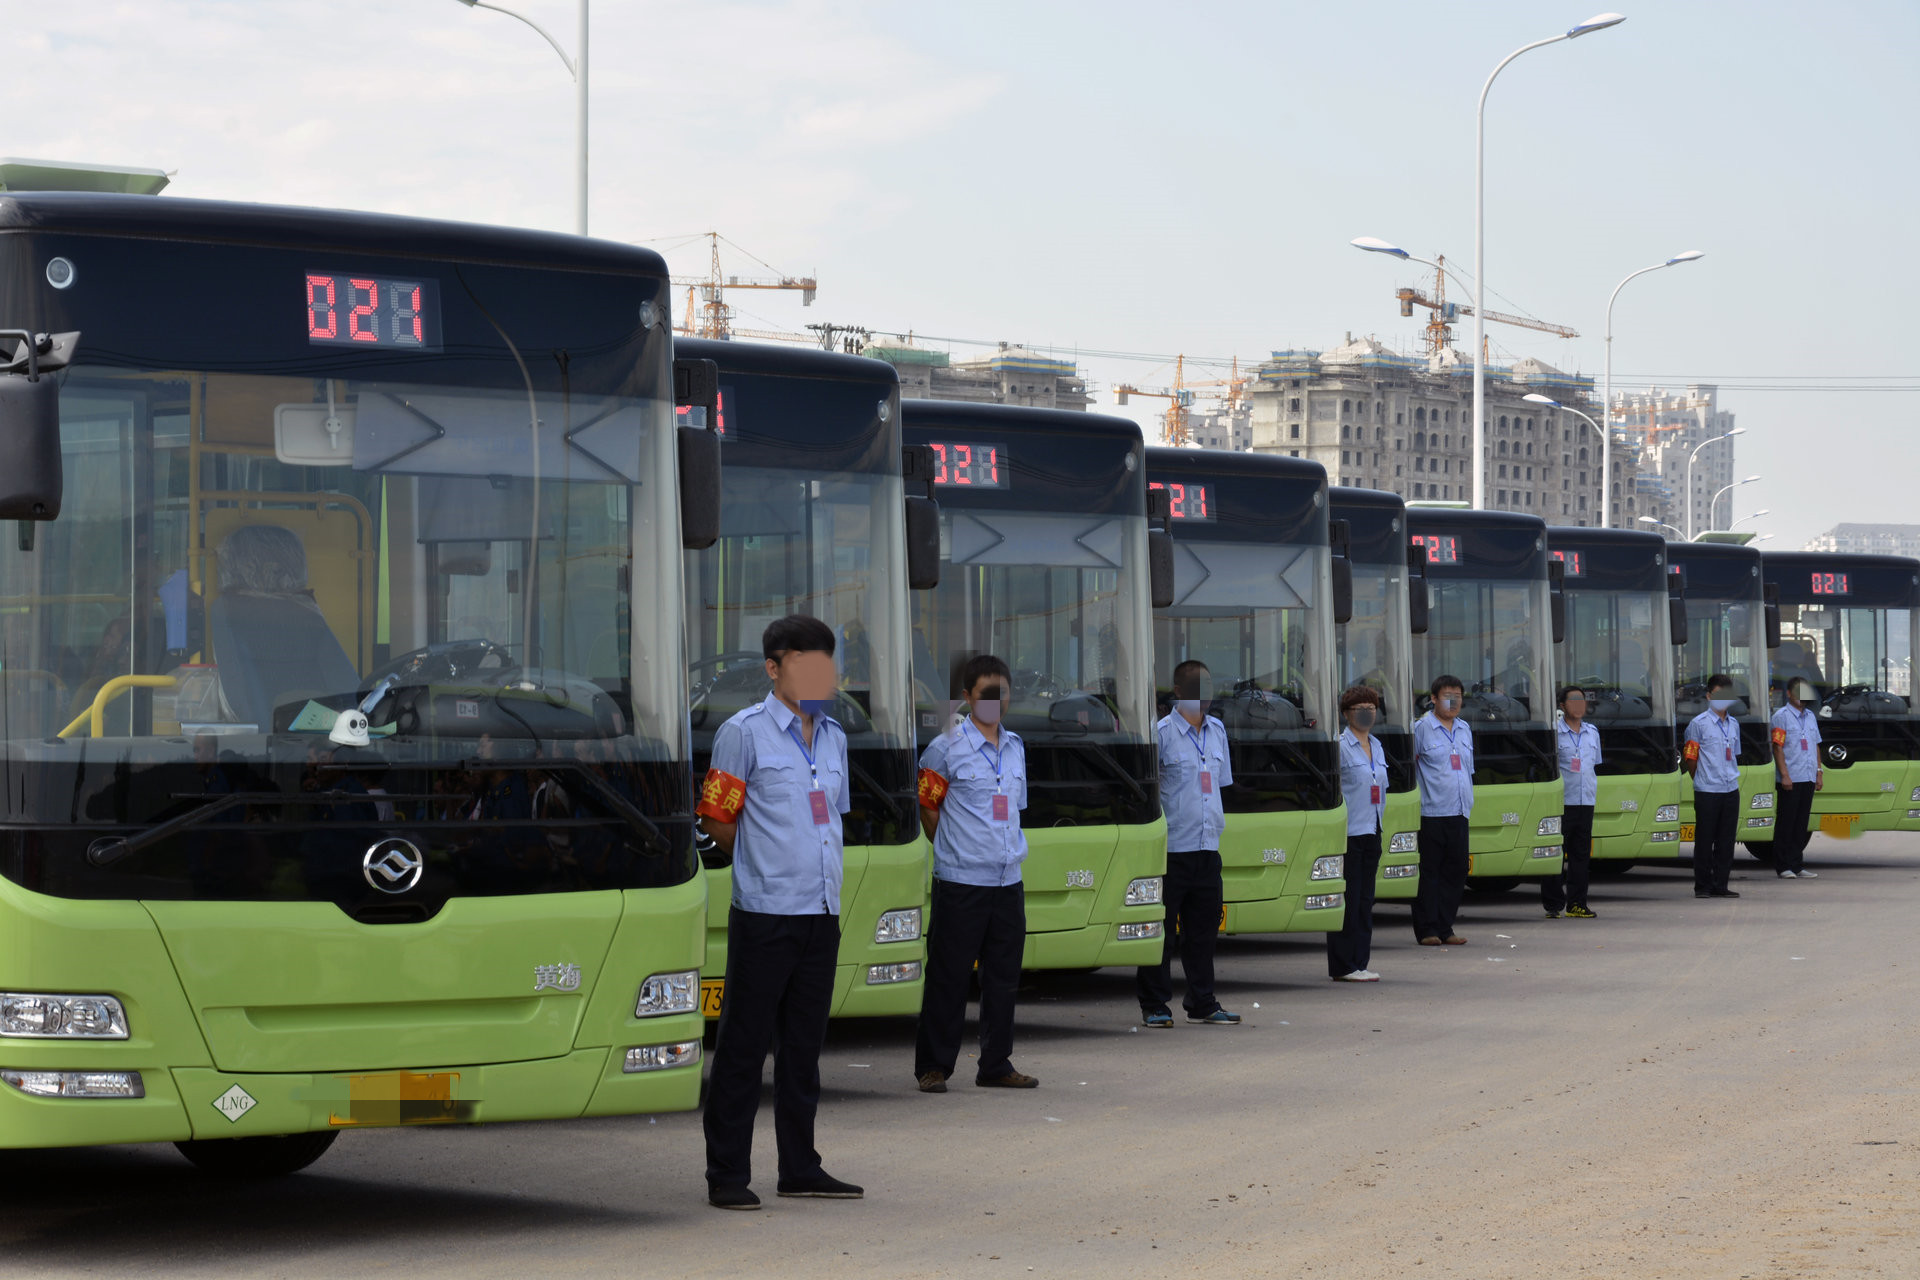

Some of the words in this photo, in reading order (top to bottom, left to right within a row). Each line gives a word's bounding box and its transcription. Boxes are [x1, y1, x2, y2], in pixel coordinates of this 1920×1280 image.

[306, 274, 422, 342] 021
[1149, 482, 1207, 518] 21
[1812, 573, 1848, 594] 021
[704, 778, 742, 815] 全员
[221, 1095, 249, 1111] LNG
